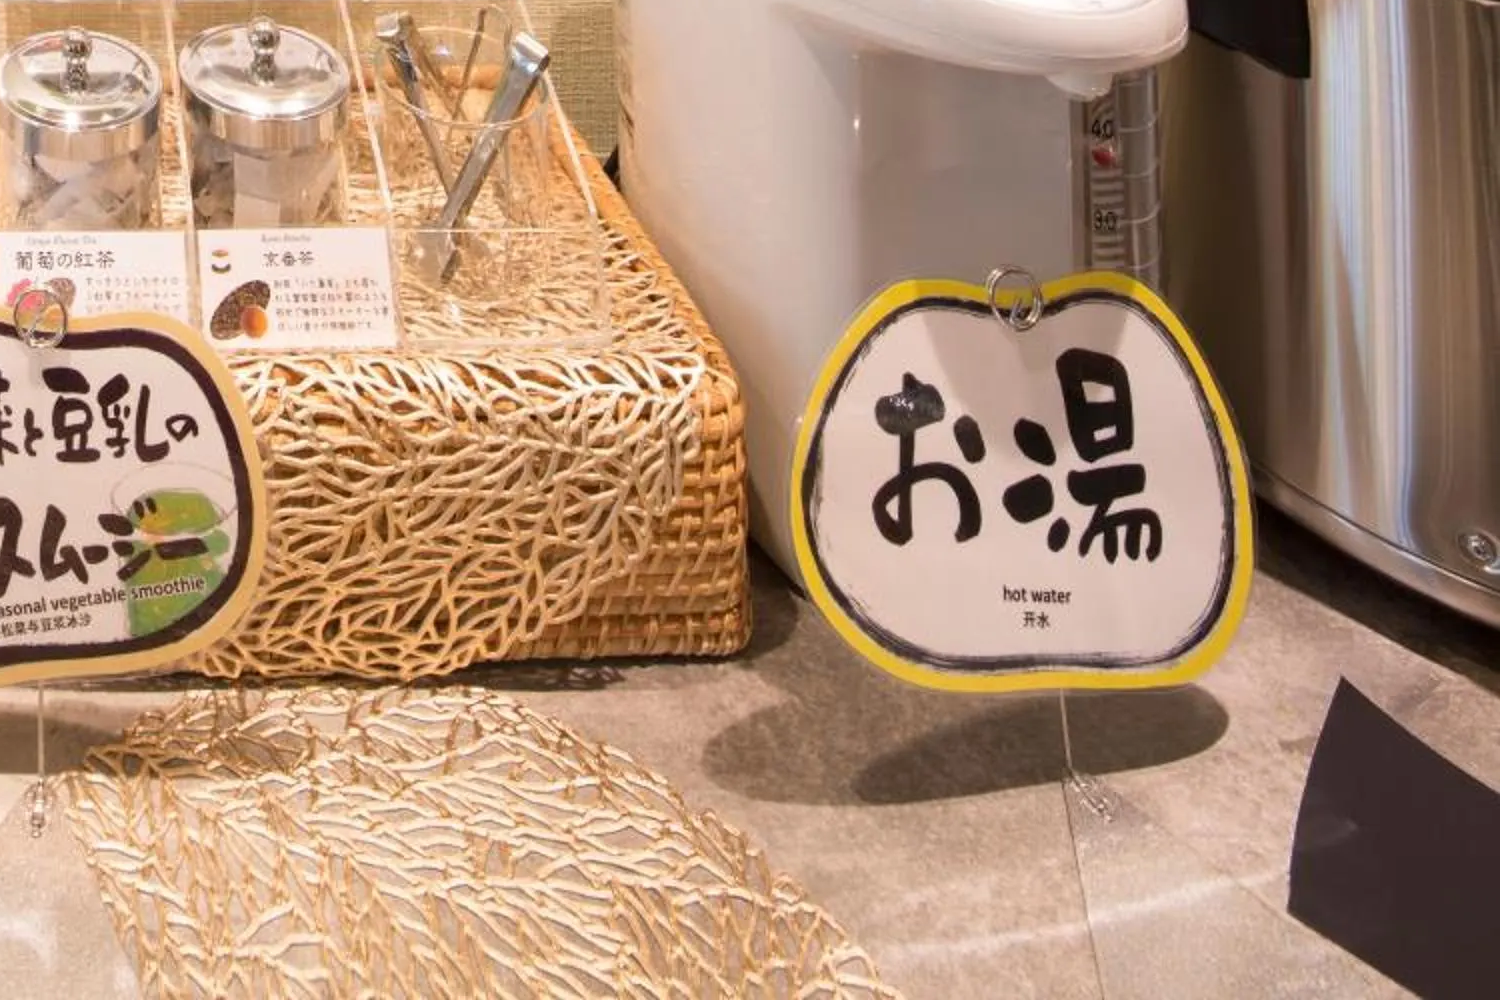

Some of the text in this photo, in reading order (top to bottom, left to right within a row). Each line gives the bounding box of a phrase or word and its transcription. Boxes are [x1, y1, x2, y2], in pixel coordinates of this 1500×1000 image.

[16, 251, 116, 270] 葡萄の紅茶
[262, 250, 315, 267] 京番茶
[872, 348, 1162, 564] お湯
[51, 587, 127, 614] vegetable
[130, 576, 206, 600] smoothie
[1002, 585, 1071, 604] hot water
[1023, 610, 1051, 629] 开水
